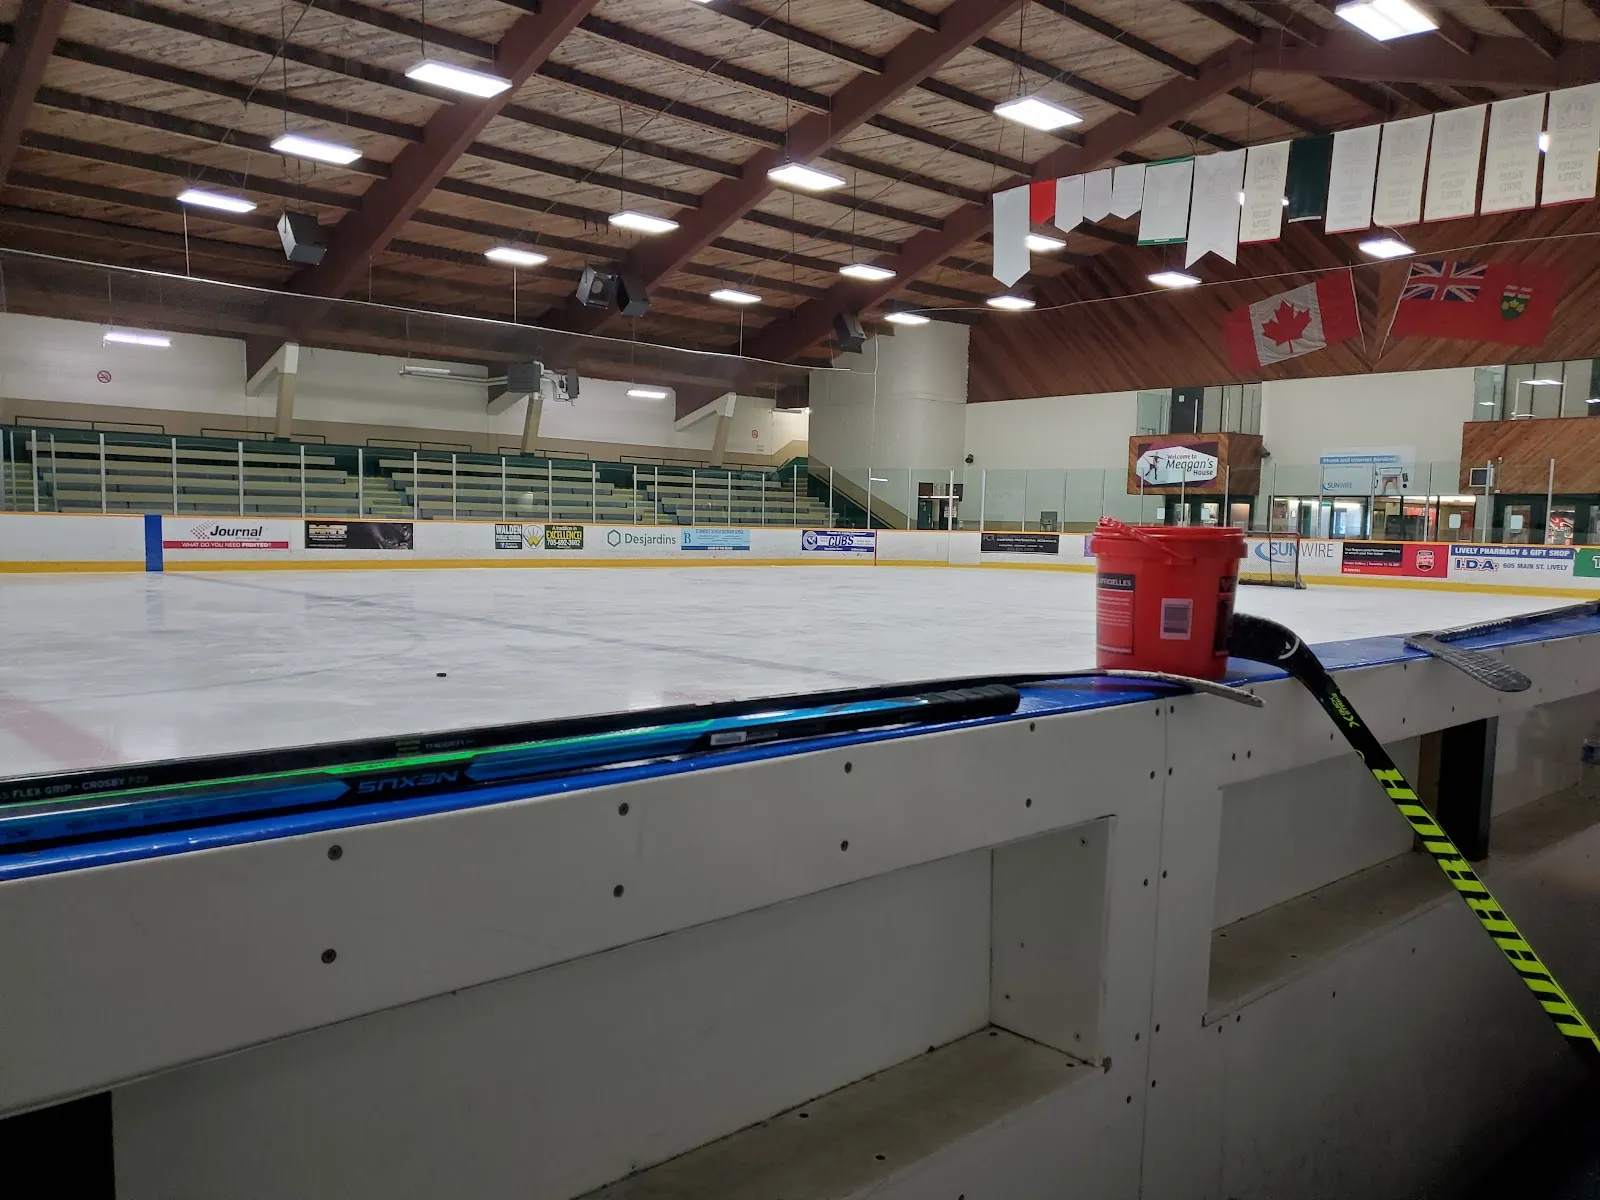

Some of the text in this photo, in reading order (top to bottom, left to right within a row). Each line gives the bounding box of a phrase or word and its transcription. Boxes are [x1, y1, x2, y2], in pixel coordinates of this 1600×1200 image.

[1165, 458, 1214, 472] Meagan's
[210, 525, 263, 537] Journal
[495, 524, 522, 535] WALDEN
[546, 530, 582, 540] EXCELLENCE!
[624, 533, 677, 546] Desjardins
[828, 535, 854, 547] CUBS
[1480, 547, 1521, 555] PHARMACY
[12, 787, 42, 799] FLEX
[44, 783, 72, 795] GRIP
[81, 777, 125, 791] CROSBY
[358, 770, 459, 794] NEXUS
